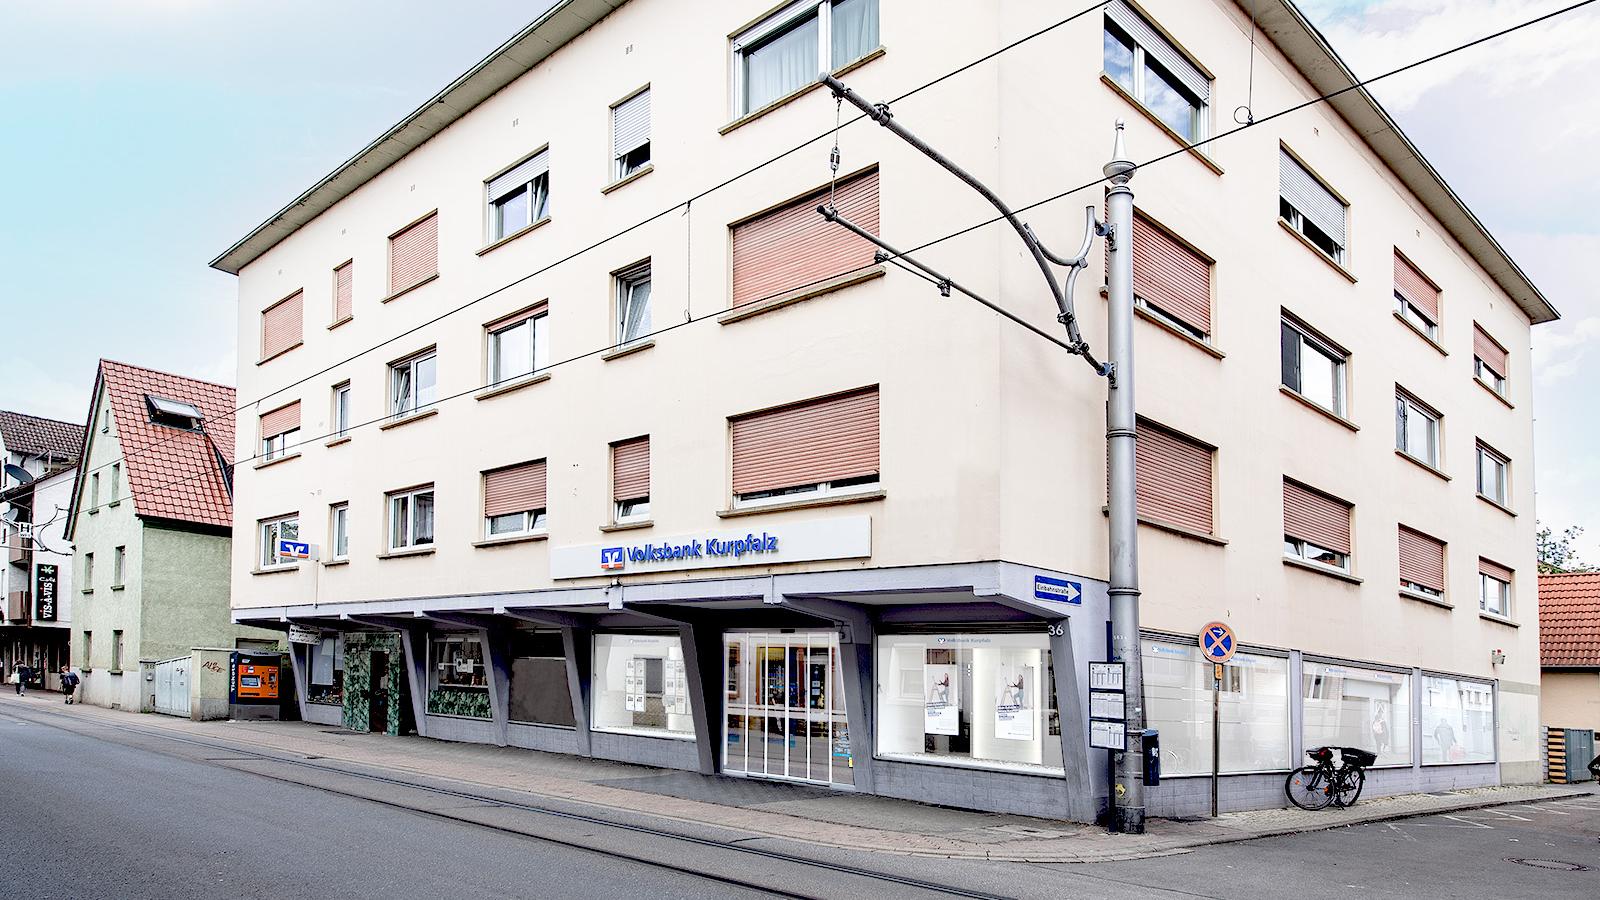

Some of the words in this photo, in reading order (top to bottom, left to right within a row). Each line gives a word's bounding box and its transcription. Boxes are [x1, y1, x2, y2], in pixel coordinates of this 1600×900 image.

[20, 524, 30, 533] H
[627, 540, 702, 562] Volksbank
[706, 532, 778, 558] Kurpfalz
[1037, 584, 1068, 595] Einbahnstraße
[1048, 625, 1064, 636] 36
